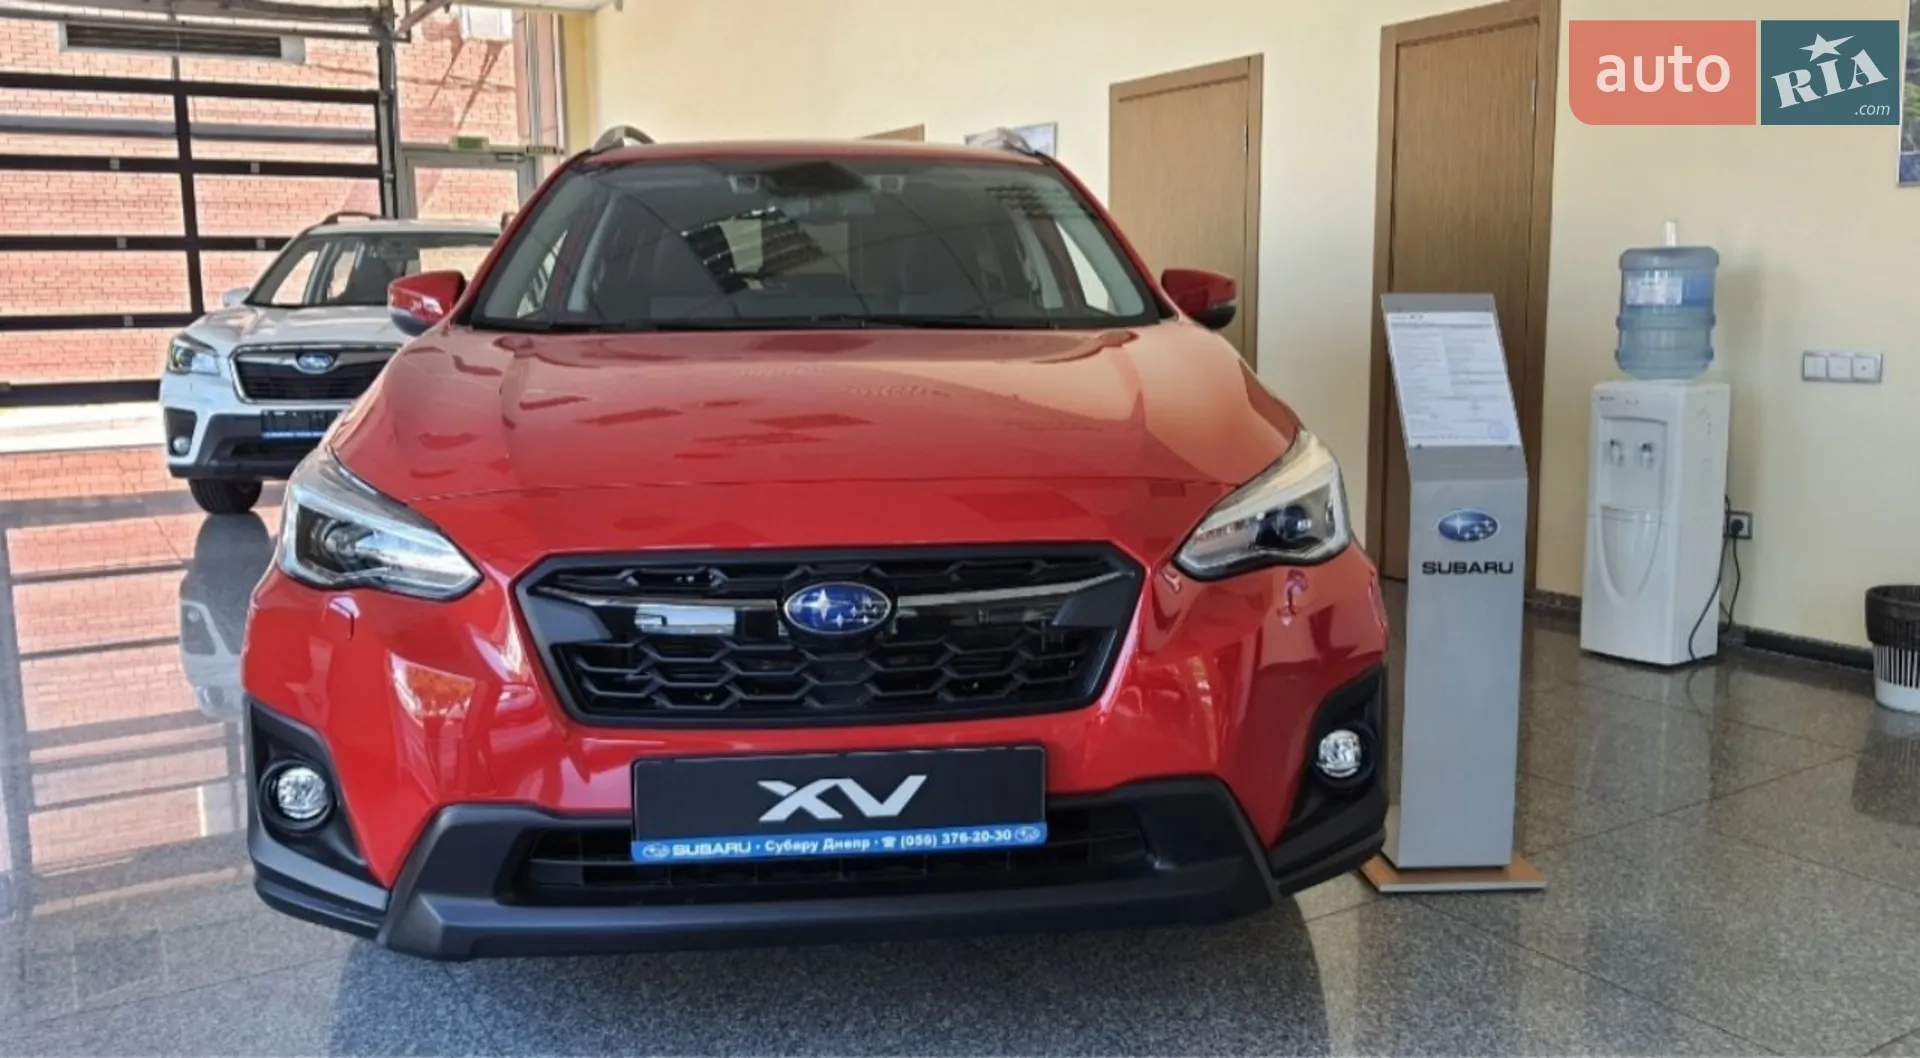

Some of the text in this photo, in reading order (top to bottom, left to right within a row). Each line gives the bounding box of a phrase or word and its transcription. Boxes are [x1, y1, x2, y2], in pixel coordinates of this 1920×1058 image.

[1422, 561, 1514, 575] SUBARU
[757, 774, 928, 823] XV
[673, 841, 751, 857] SUBARU
[765, 838, 819, 854] Субару
[823, 837, 870, 852] Днепр
